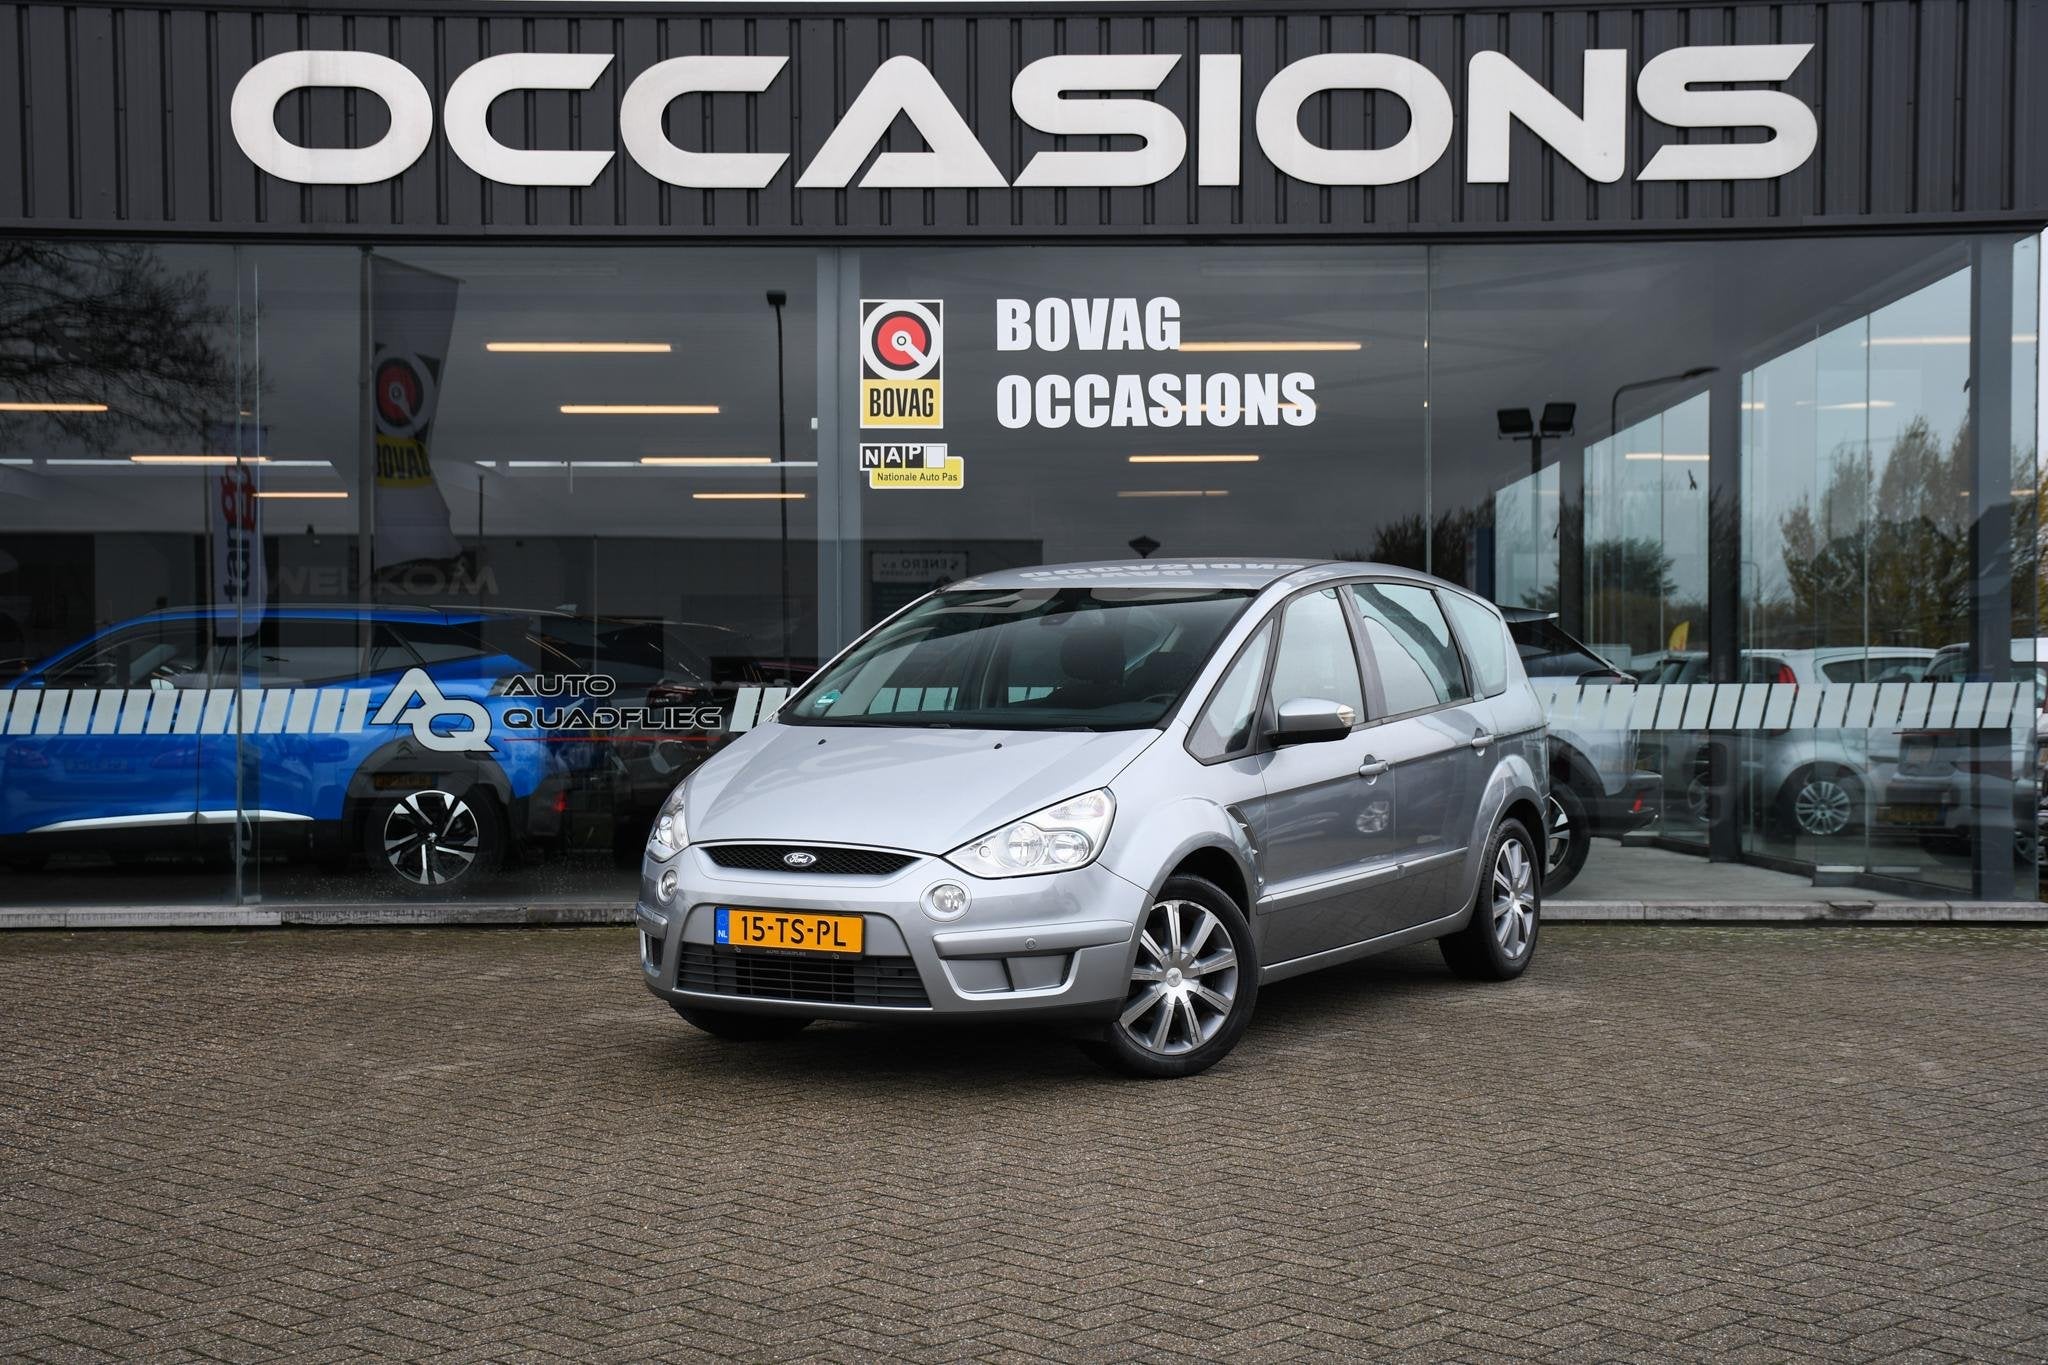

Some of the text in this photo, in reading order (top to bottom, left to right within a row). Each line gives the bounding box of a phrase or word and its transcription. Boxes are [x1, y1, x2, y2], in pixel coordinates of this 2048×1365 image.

[231, 44, 1817, 188] OCCASIONS
[996, 297, 1182, 351] BOVAG
[870, 388, 934, 417] BOVAG
[996, 373, 1317, 428] OCCASIONS
[865, 445, 922, 466] NAP
[877, 472, 958, 482] Nationale Auto Pas
[501, 674, 616, 698] AUTO
[371, 668, 497, 752] AQ
[502, 707, 722, 730] QUADFLIEG
[717, 915, 847, 947] NL 15-TS-PL
